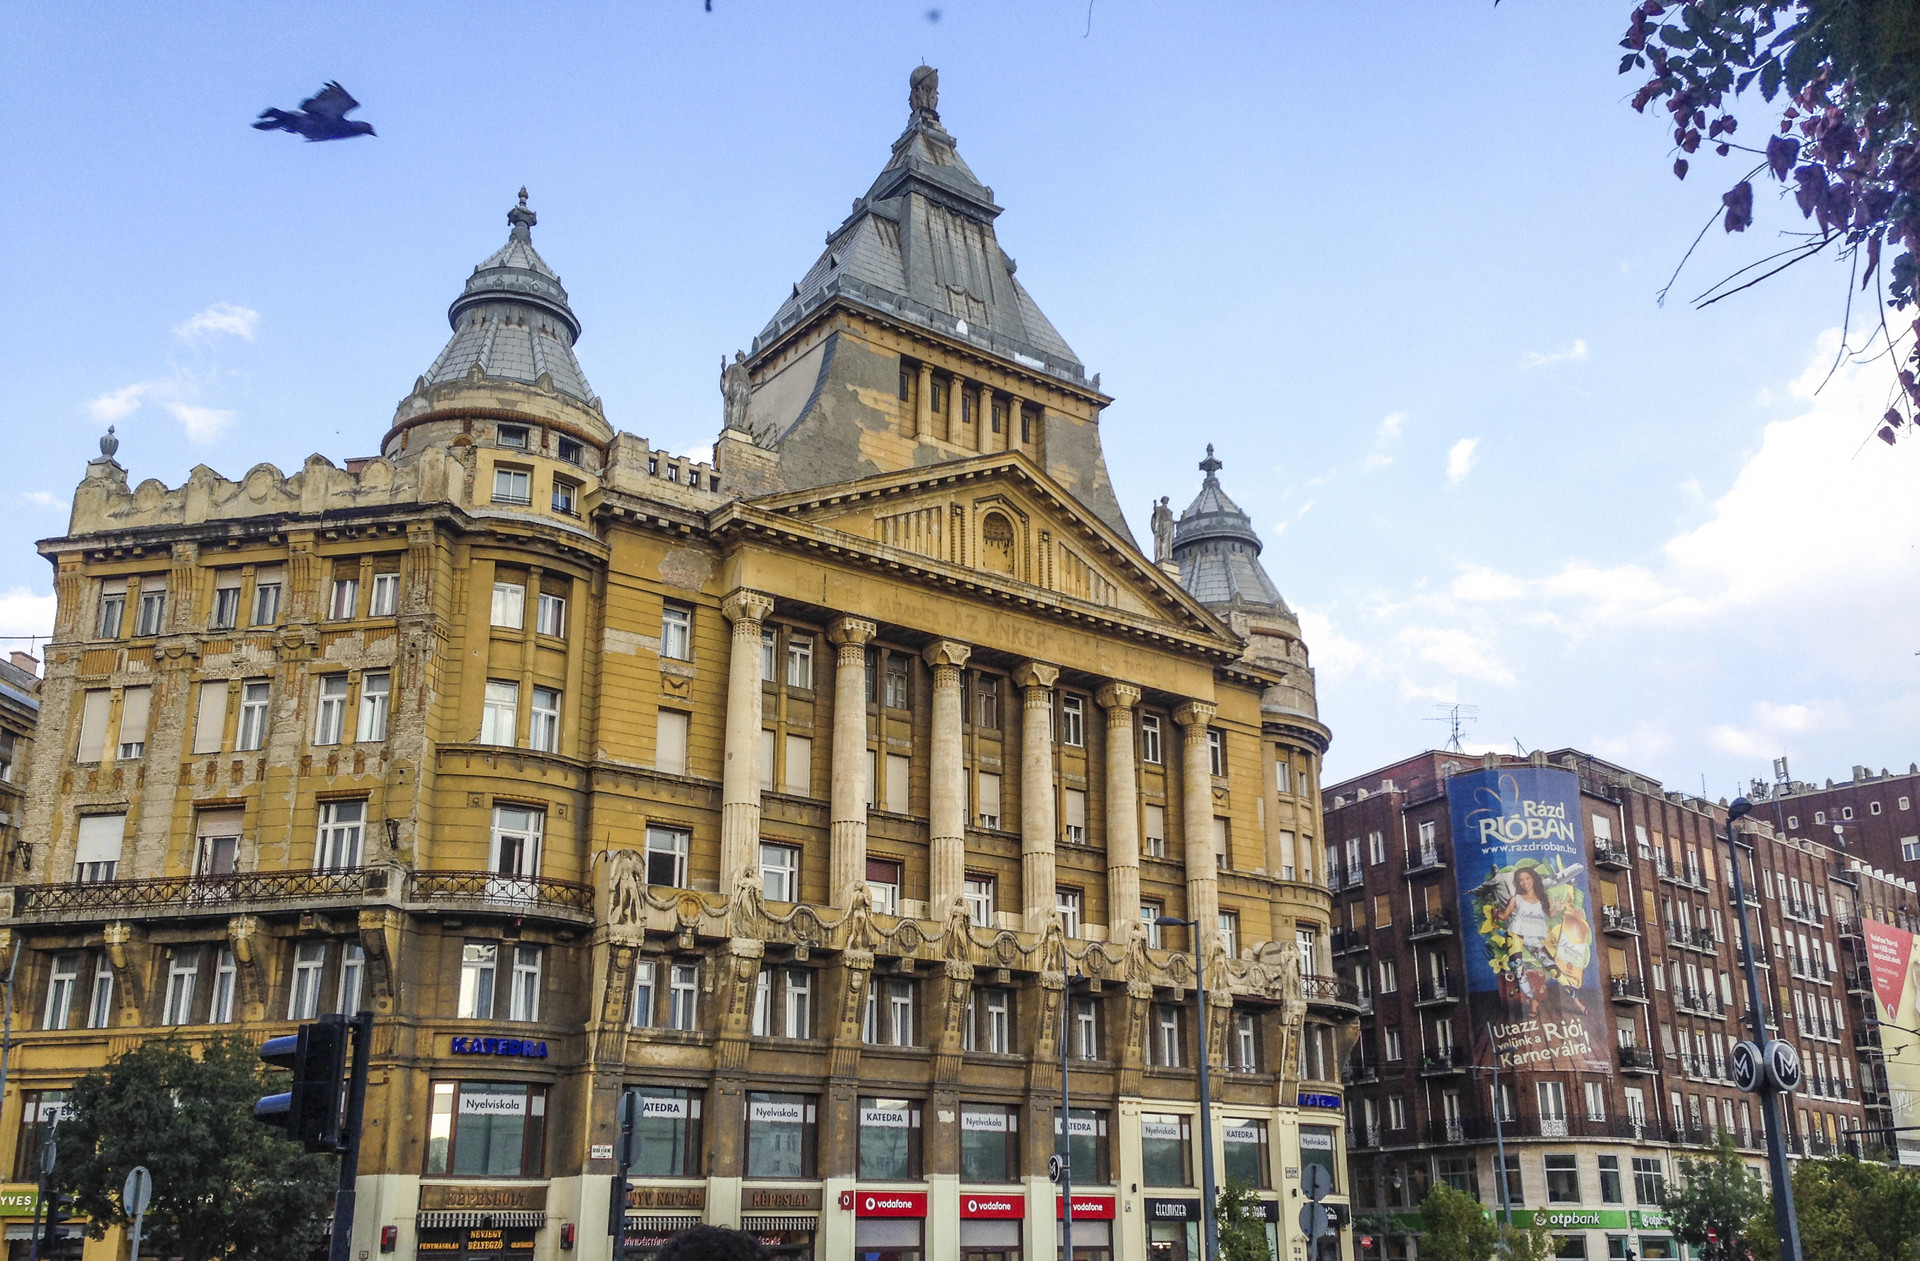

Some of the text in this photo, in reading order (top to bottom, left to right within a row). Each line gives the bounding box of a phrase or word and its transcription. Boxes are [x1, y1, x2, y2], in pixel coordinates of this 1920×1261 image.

[1522, 800, 1566, 820] Rázd
[1479, 813, 1575, 844] RIÓBAN
[1481, 842, 1577, 855] www.razdrioban.hu
[1493, 1018, 1585, 1042] Utazz Riói
[1534, 1035, 1542, 1044] a
[451, 1036, 548, 1058] KATEDRA
[1500, 1031, 1593, 1069] Karneválra!
[466, 1099, 520, 1111] Nyelviskola
[643, 1102, 680, 1113] ATEDRA
[756, 1107, 798, 1119] Nyelviskola
[866, 1112, 903, 1123] KATEDRA
[966, 1117, 1002, 1128] Nyelviskola
[1060, 1123, 1092, 1131] TEDRA
[1145, 1126, 1176, 1137] Nyelviskola
[1226, 1130, 1254, 1139] KATEDRA
[0, 1196, 31, 1206] YVES
[877, 1199, 912, 1209] vodafone
[978, 1202, 1011, 1211] vodafone
[1072, 1202, 1103, 1211] vodafone
[1550, 1211, 1600, 1227] otpbank
